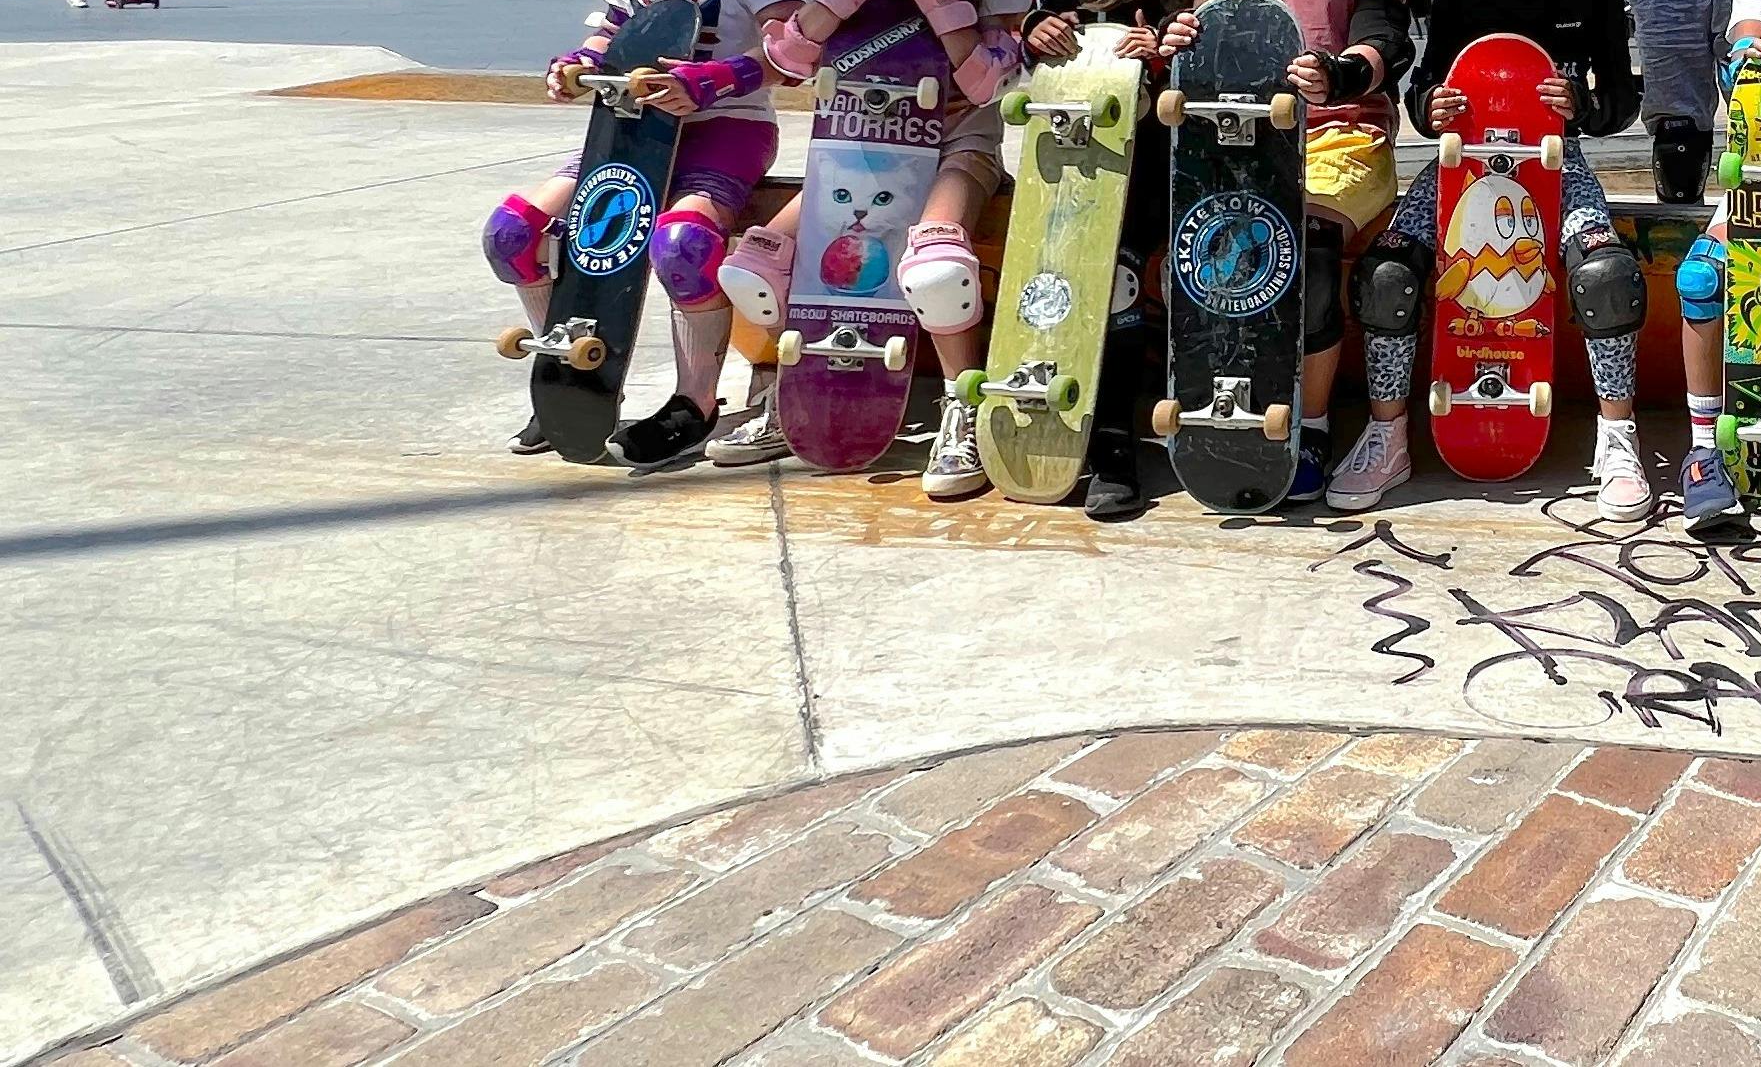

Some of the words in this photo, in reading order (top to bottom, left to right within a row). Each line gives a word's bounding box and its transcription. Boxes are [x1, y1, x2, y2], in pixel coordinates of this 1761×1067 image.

[819, 94, 911, 119] VANA
[825, 111, 942, 145] TORRES
[617, 205, 652, 264] SKATE
[1178, 208, 1211, 274] SKATE
[1210, 197, 1266, 214] NOW
[1275, 225, 1292, 270] SCHOOL
[576, 253, 613, 271] NOW
[789, 308, 827, 320] MEOW
[830, 310, 916, 325] SKATEBOARDS
[1457, 346, 1525, 360] birdhouse
